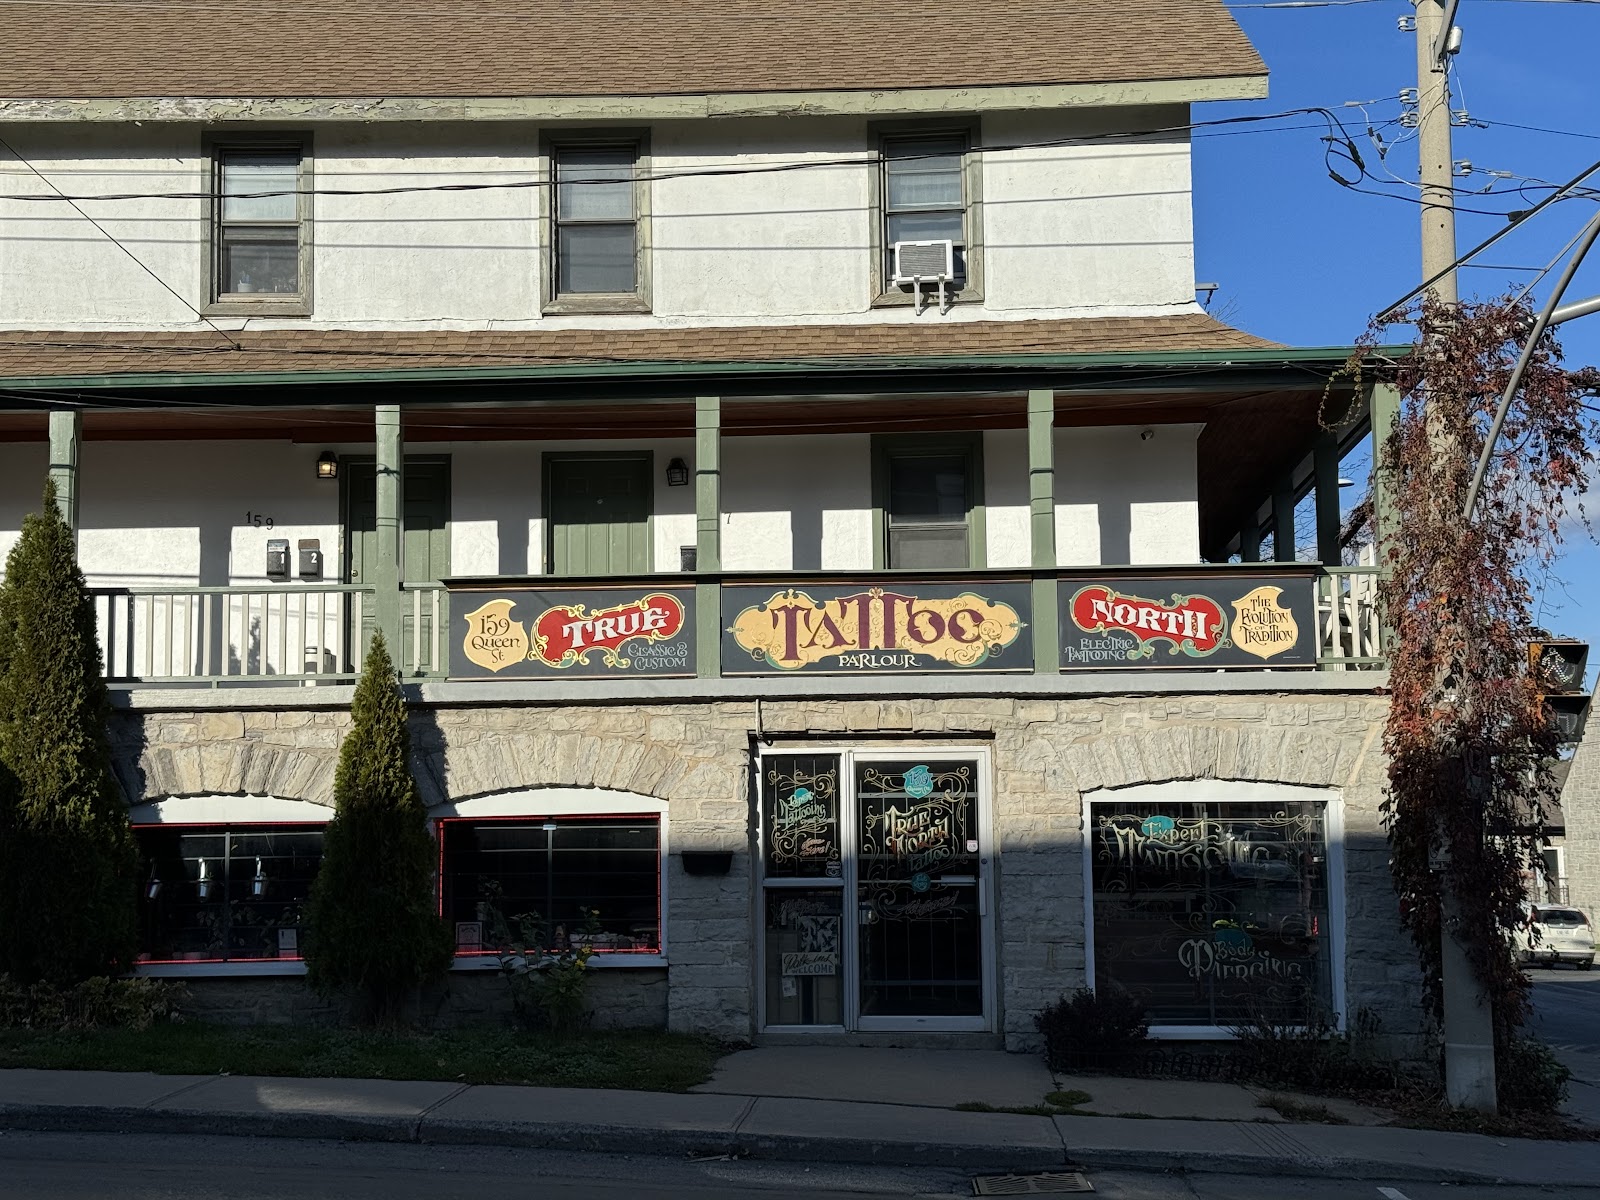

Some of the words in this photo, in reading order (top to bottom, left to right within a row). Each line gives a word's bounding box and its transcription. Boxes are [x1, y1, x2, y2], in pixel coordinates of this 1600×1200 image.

[245, 511, 274, 530] 159
[281, 553, 285, 564] 1
[312, 552, 318, 563] 2
[1250, 595, 1271, 611] THE
[480, 613, 510, 638] 159
[769, 592, 990, 661] TATTOO
[1090, 598, 1208, 641] NORTH
[1240, 607, 1289, 627] EVOLUTION
[562, 607, 670, 649] TRUE
[1239, 625, 1293, 646] TRADITION
[471, 635, 520, 651] Queen
[628, 642, 676, 657] CLASSIC
[677, 641, 688, 657] &
[1080, 636, 1134, 650] ELECTRIC
[634, 656, 687, 670] CUSTOM
[838, 654, 922, 669] PARLOUR
[1064, 646, 1126, 663] TATTOOING
[885, 804, 931, 846] TRUE
[1143, 819, 1213, 843] Expert
[887, 814, 950, 860] NORTH
[1213, 938, 1257, 962] Body
[791, 964, 834, 974] WELCOME
